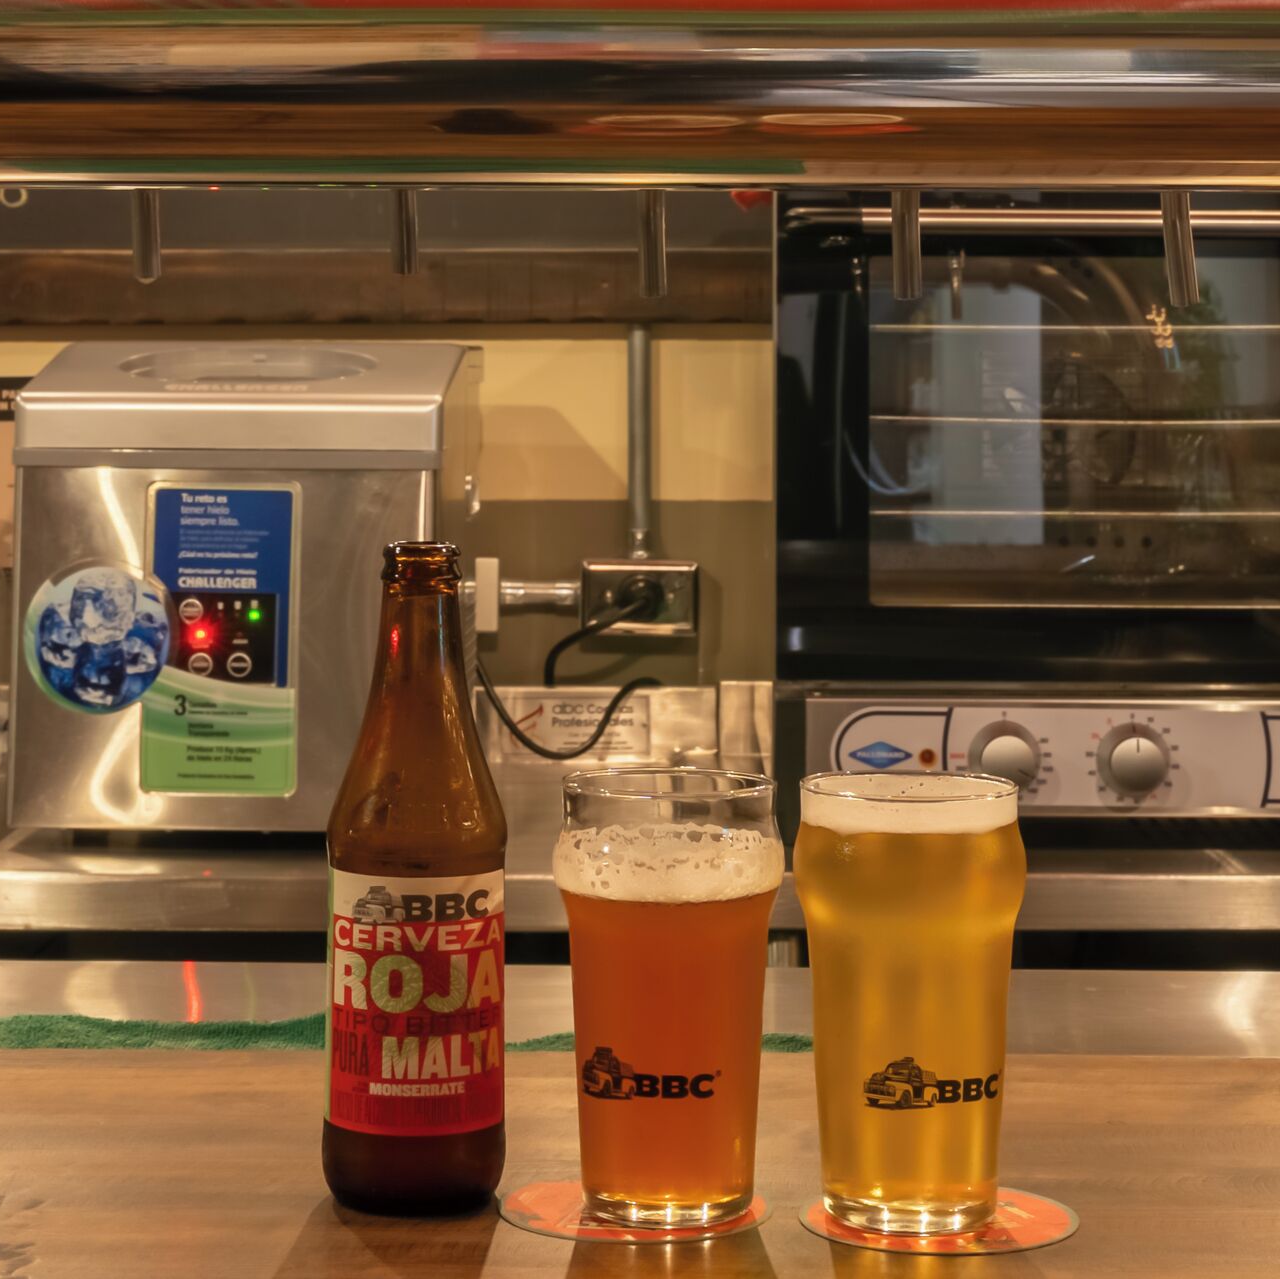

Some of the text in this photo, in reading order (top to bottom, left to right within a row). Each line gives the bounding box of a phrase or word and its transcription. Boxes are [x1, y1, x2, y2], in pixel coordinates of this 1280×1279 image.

[181, 493, 194, 503] Tu
[174, 693, 187, 717] 3
[401, 888, 490, 923] BBC
[333, 918, 502, 952] CERVEZA
[333, 948, 502, 1015] ROJA
[333, 1008, 395, 1036] TIPO
[332, 1026, 501, 1080] PURA MALTA
[369, 1080, 466, 1097] MONSERRATE
[634, 1073, 716, 1099] BBC
[936, 1071, 1000, 1104] BBC
